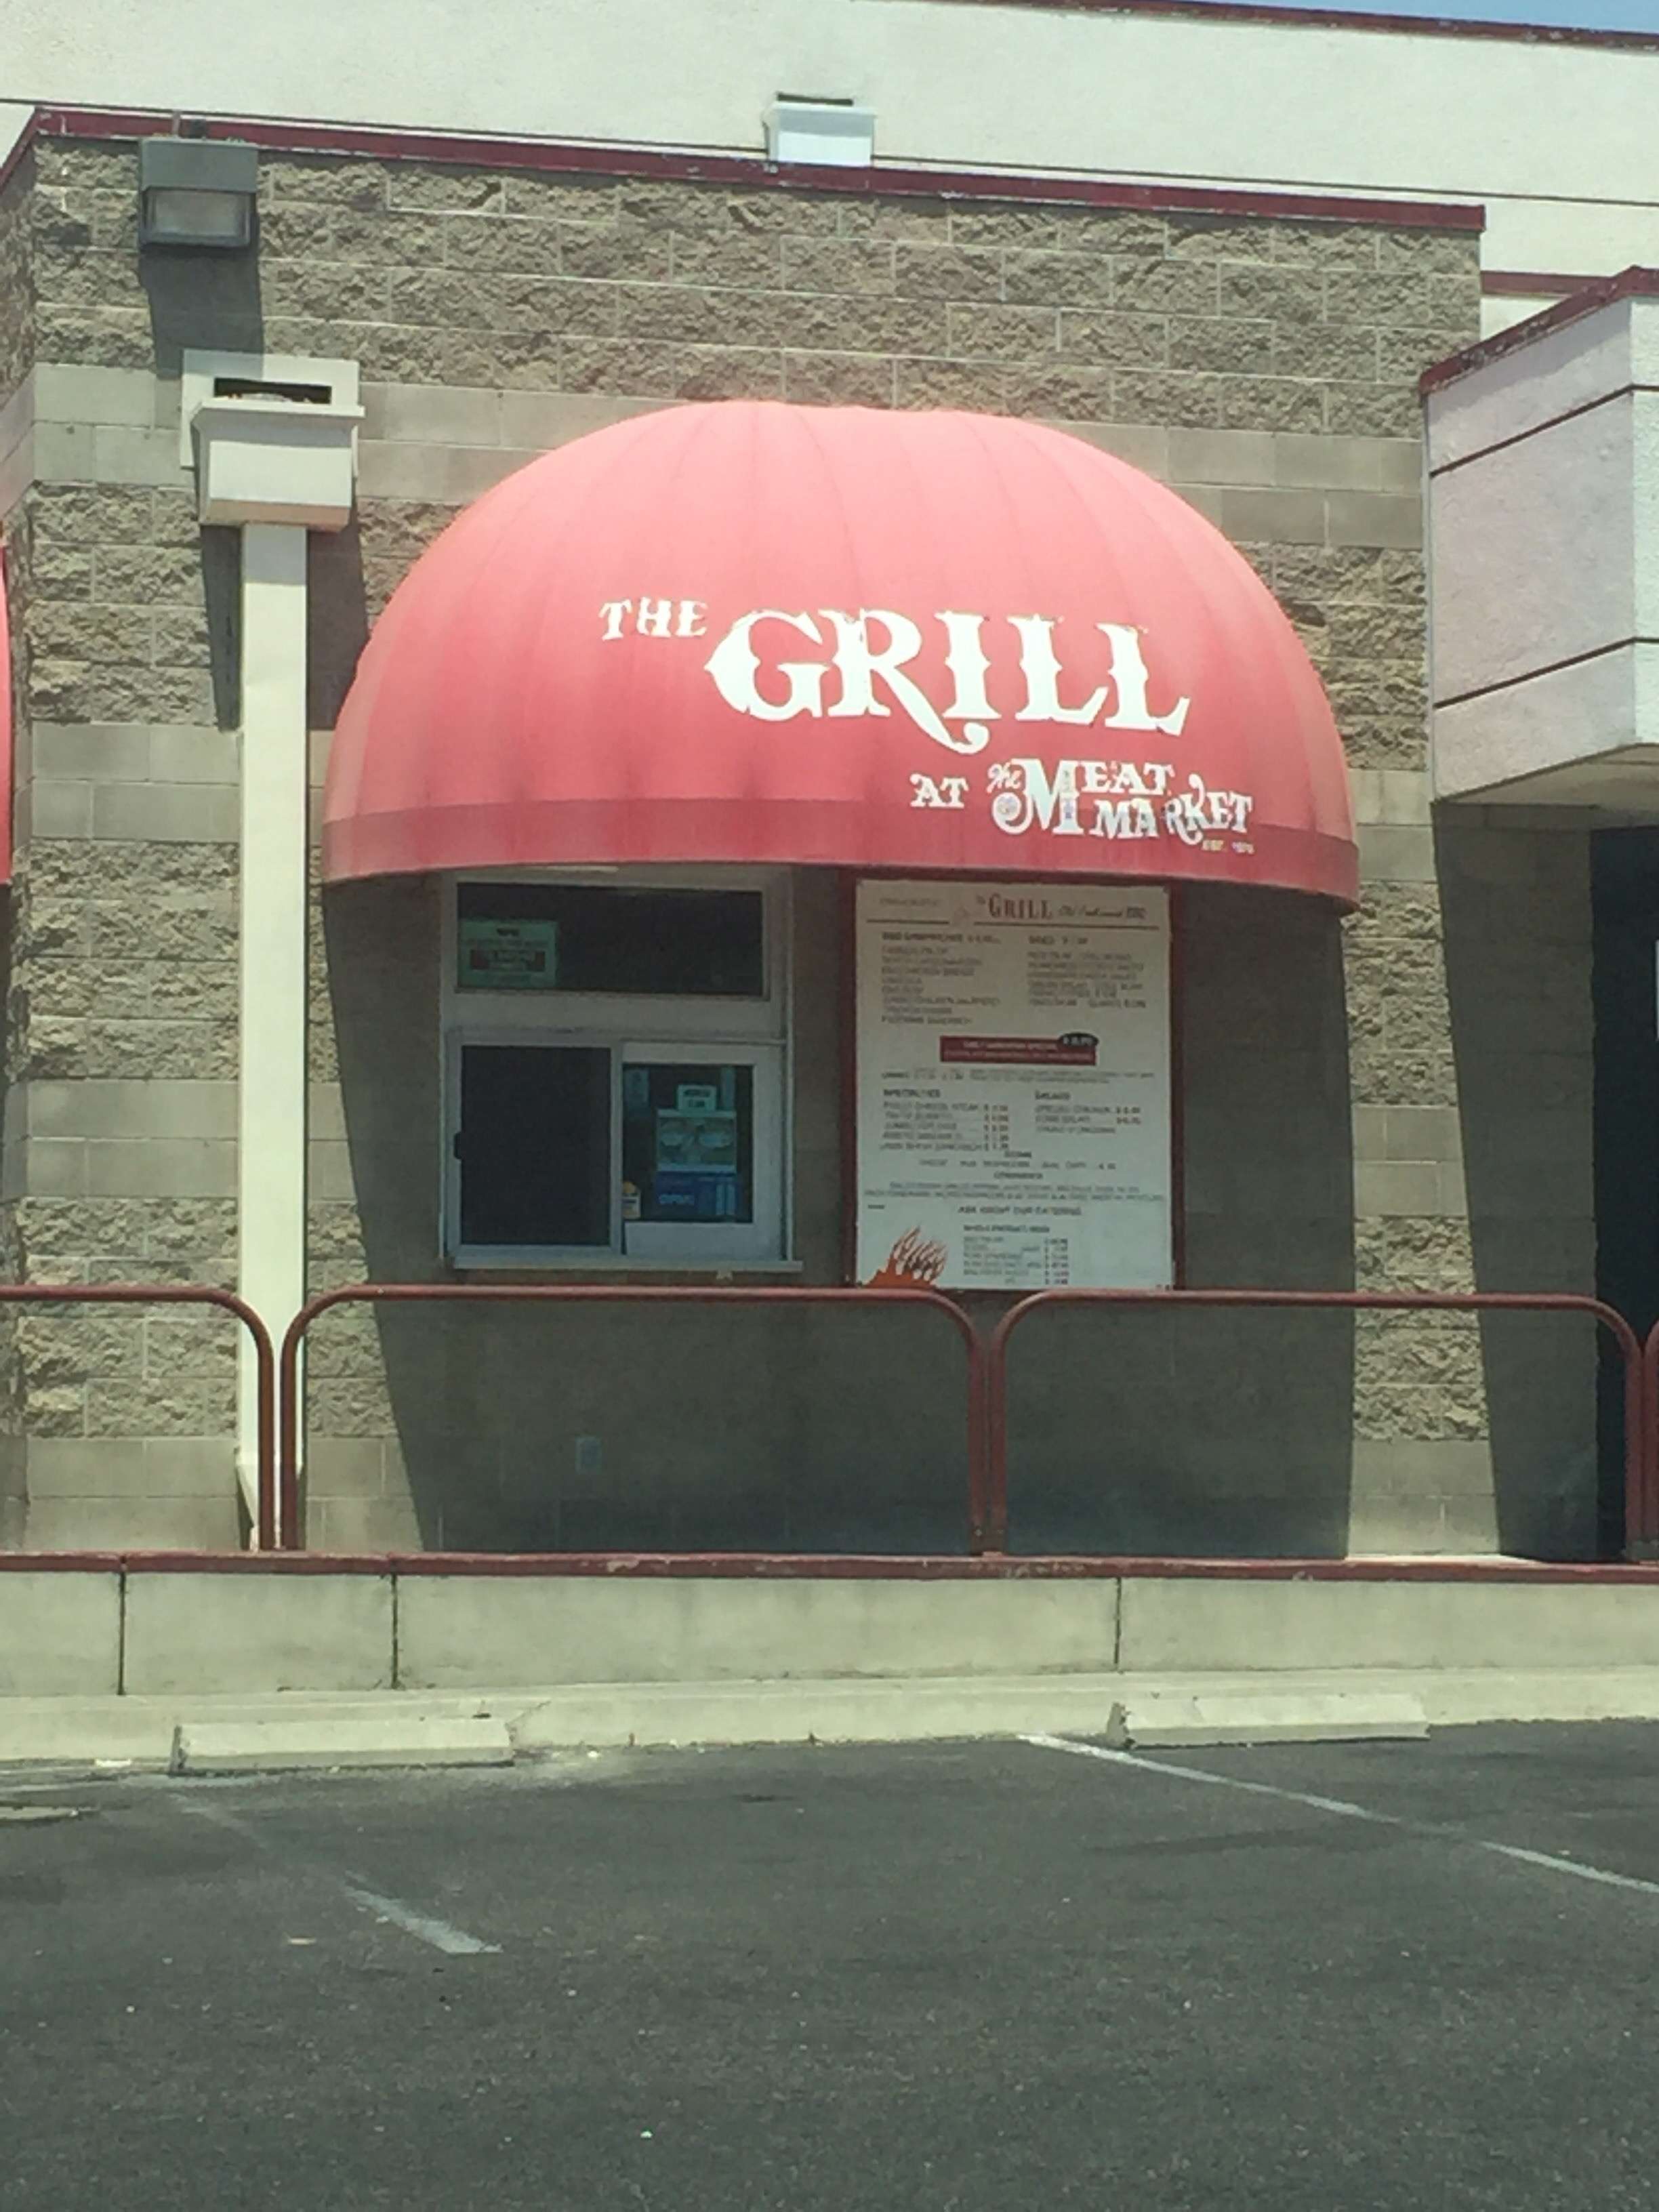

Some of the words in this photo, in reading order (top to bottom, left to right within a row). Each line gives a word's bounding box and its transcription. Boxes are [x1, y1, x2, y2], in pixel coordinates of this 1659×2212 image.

[598, 595, 708, 641] THE
[703, 608, 1191, 754] GRILL
[909, 773, 969, 809] AT
[990, 758, 1176, 836] MEAT
[1088, 773, 1253, 846] MARKET
[988, 893, 1052, 920] GRILL
